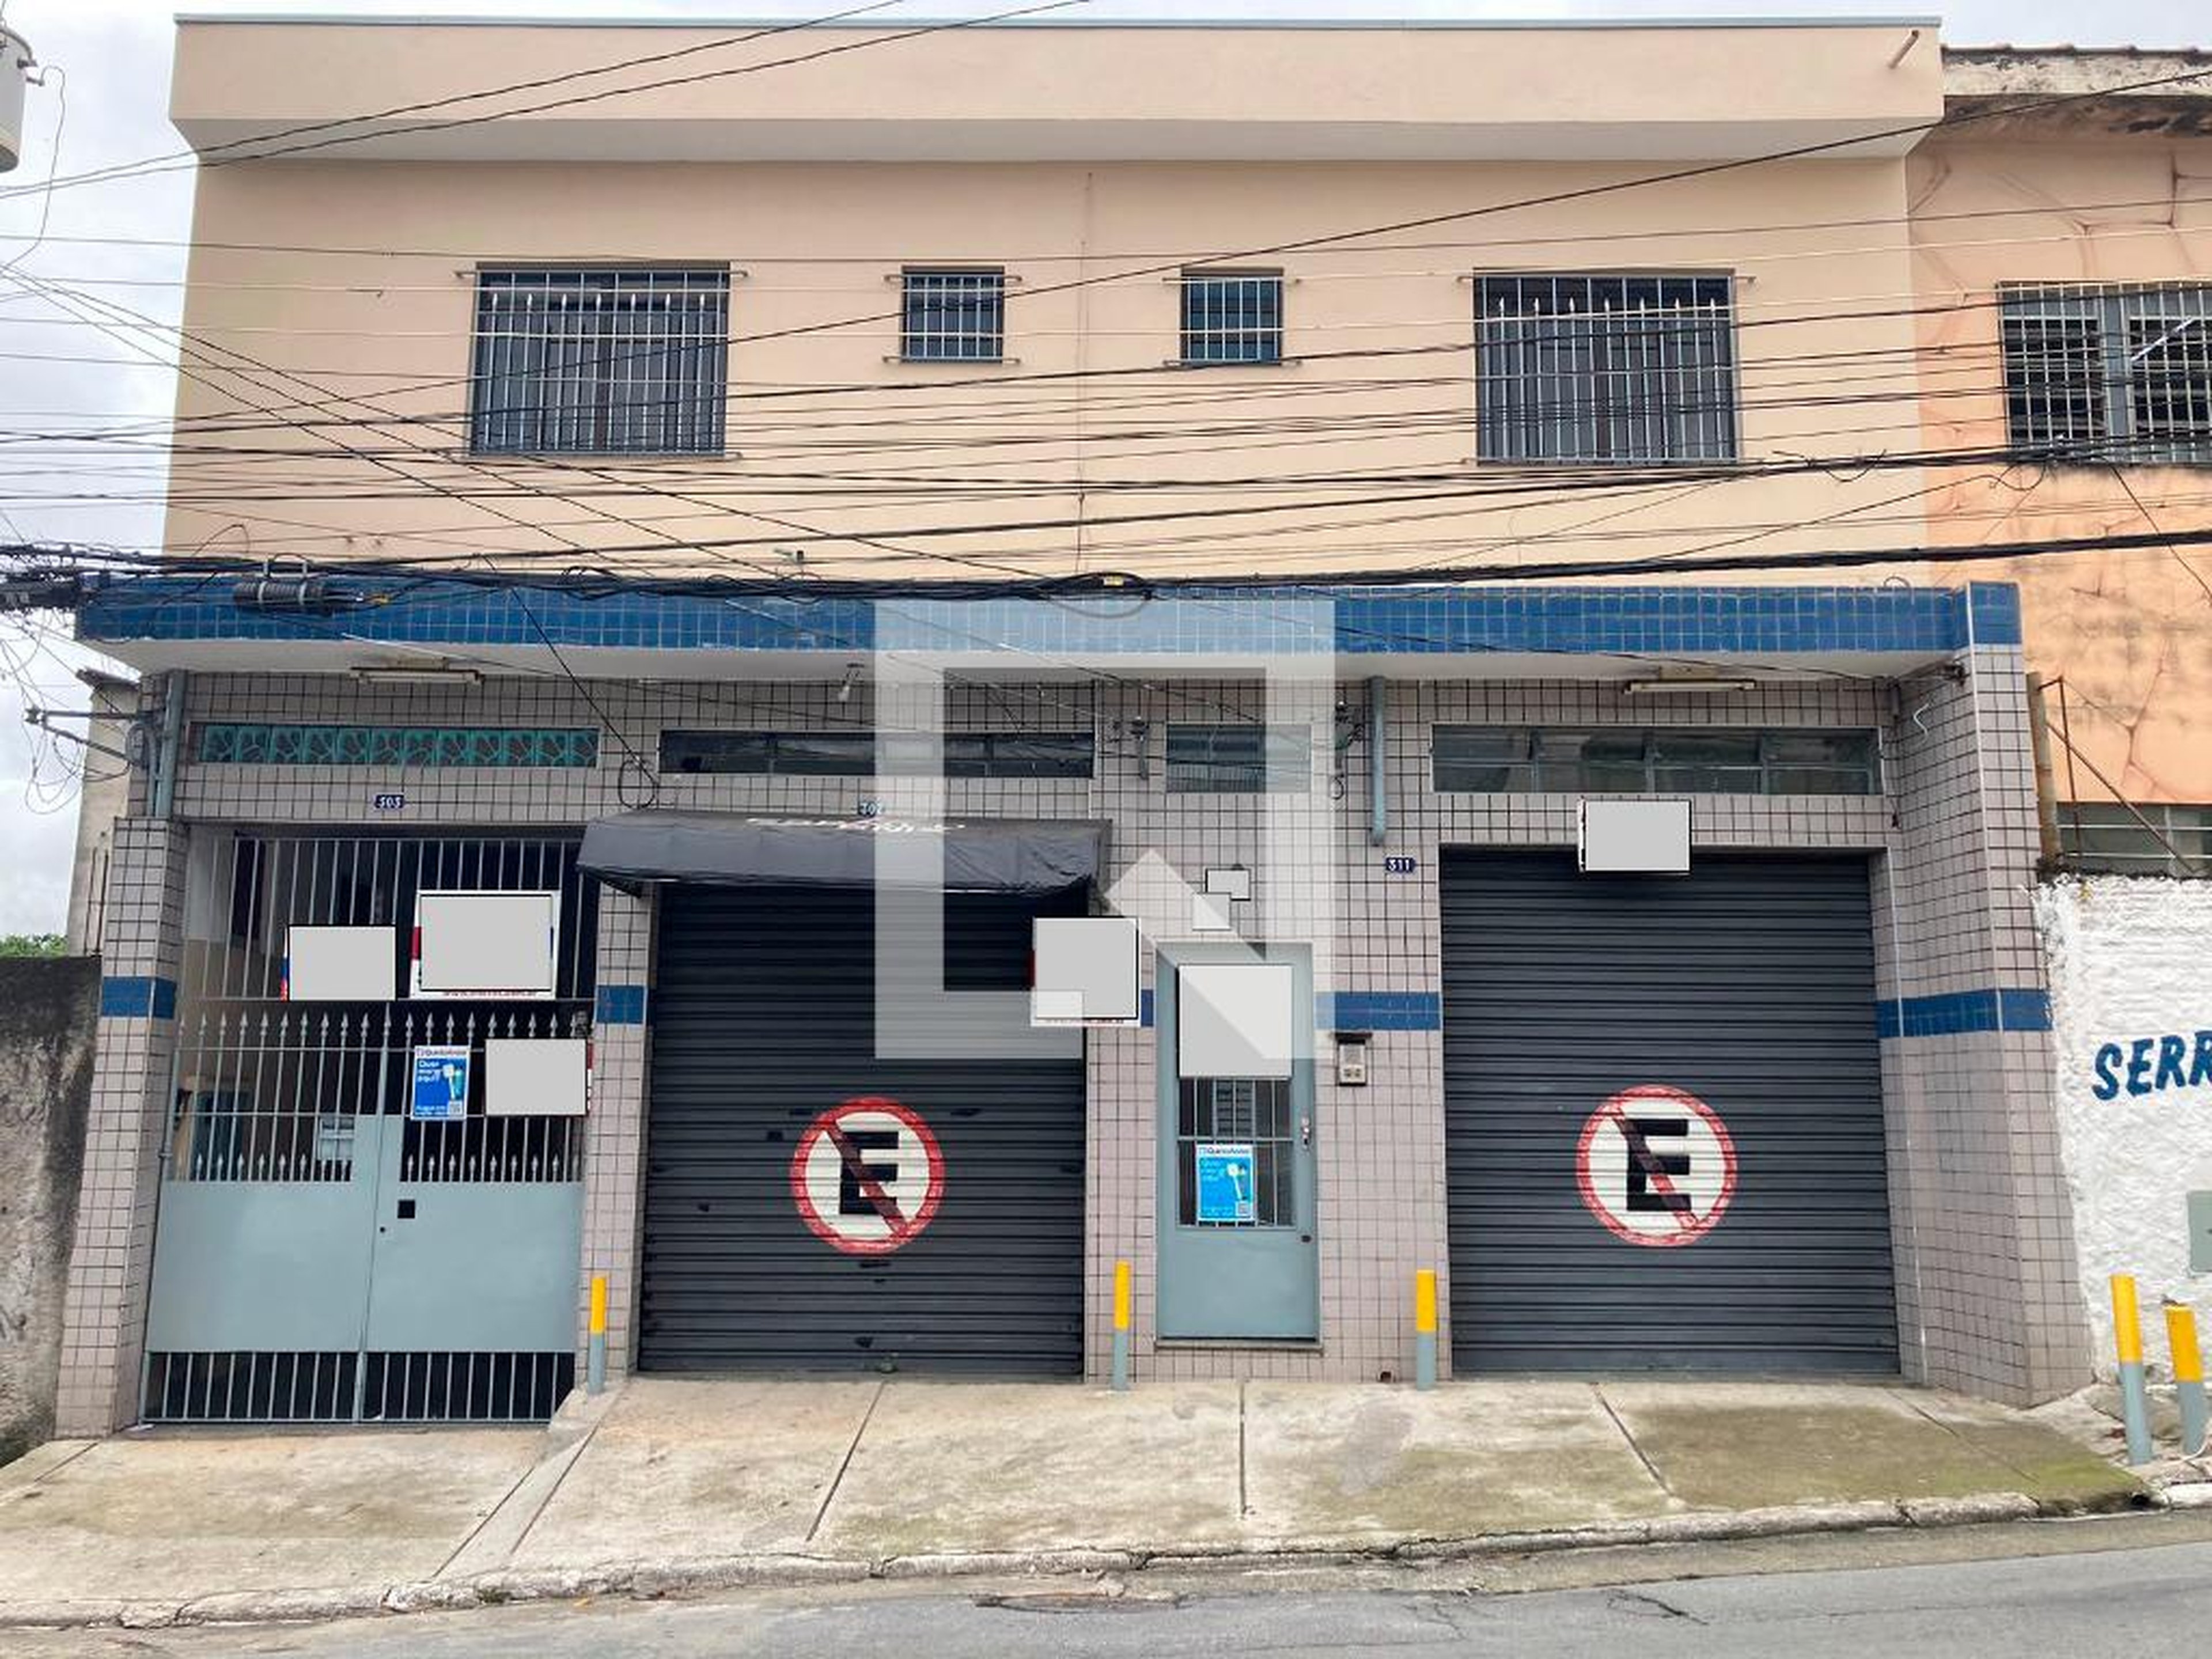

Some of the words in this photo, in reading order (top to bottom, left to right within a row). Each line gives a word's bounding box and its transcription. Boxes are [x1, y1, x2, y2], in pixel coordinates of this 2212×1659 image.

[2092, 1030, 2212, 1100] SERR
[840, 1131, 899, 1214] E
[1626, 1119, 1692, 1211] E
